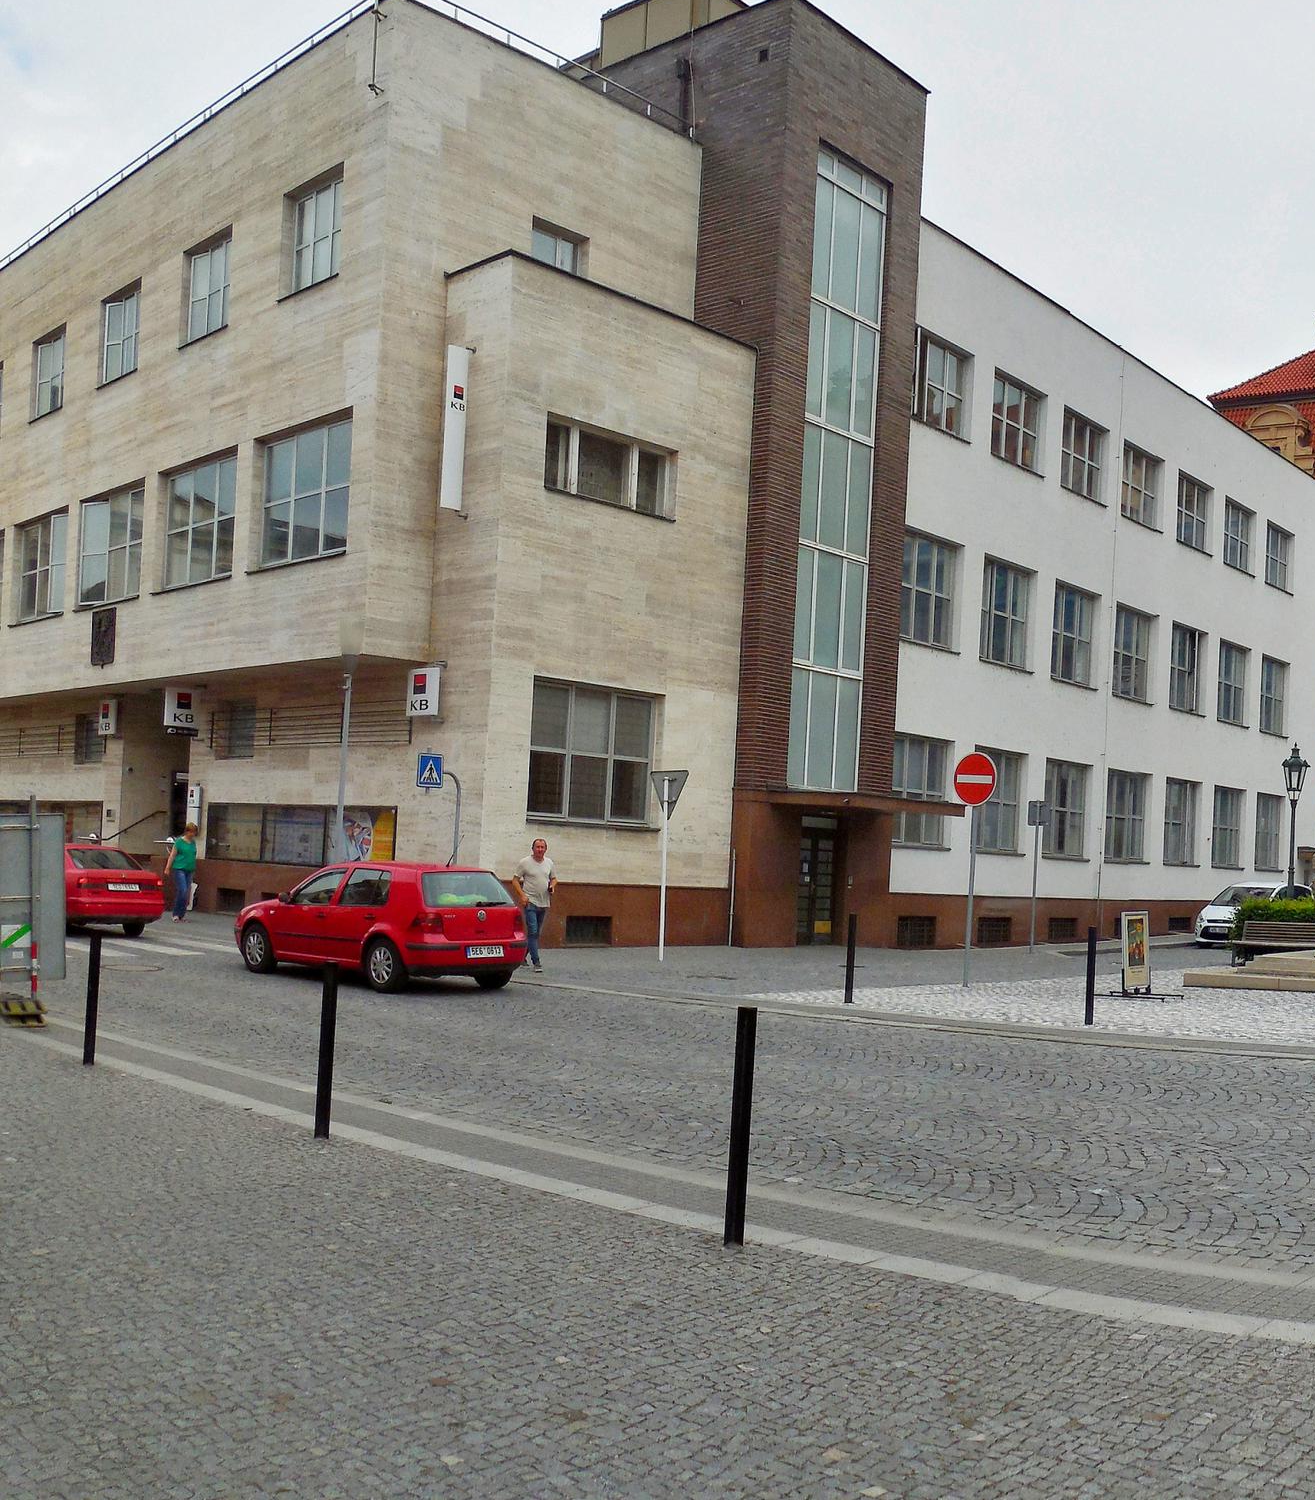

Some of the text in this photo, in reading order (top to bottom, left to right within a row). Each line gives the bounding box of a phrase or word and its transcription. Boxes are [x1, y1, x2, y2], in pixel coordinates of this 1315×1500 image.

[450, 401, 465, 411] KB
[410, 699, 429, 711] KB
[173, 713, 194, 723] KB
